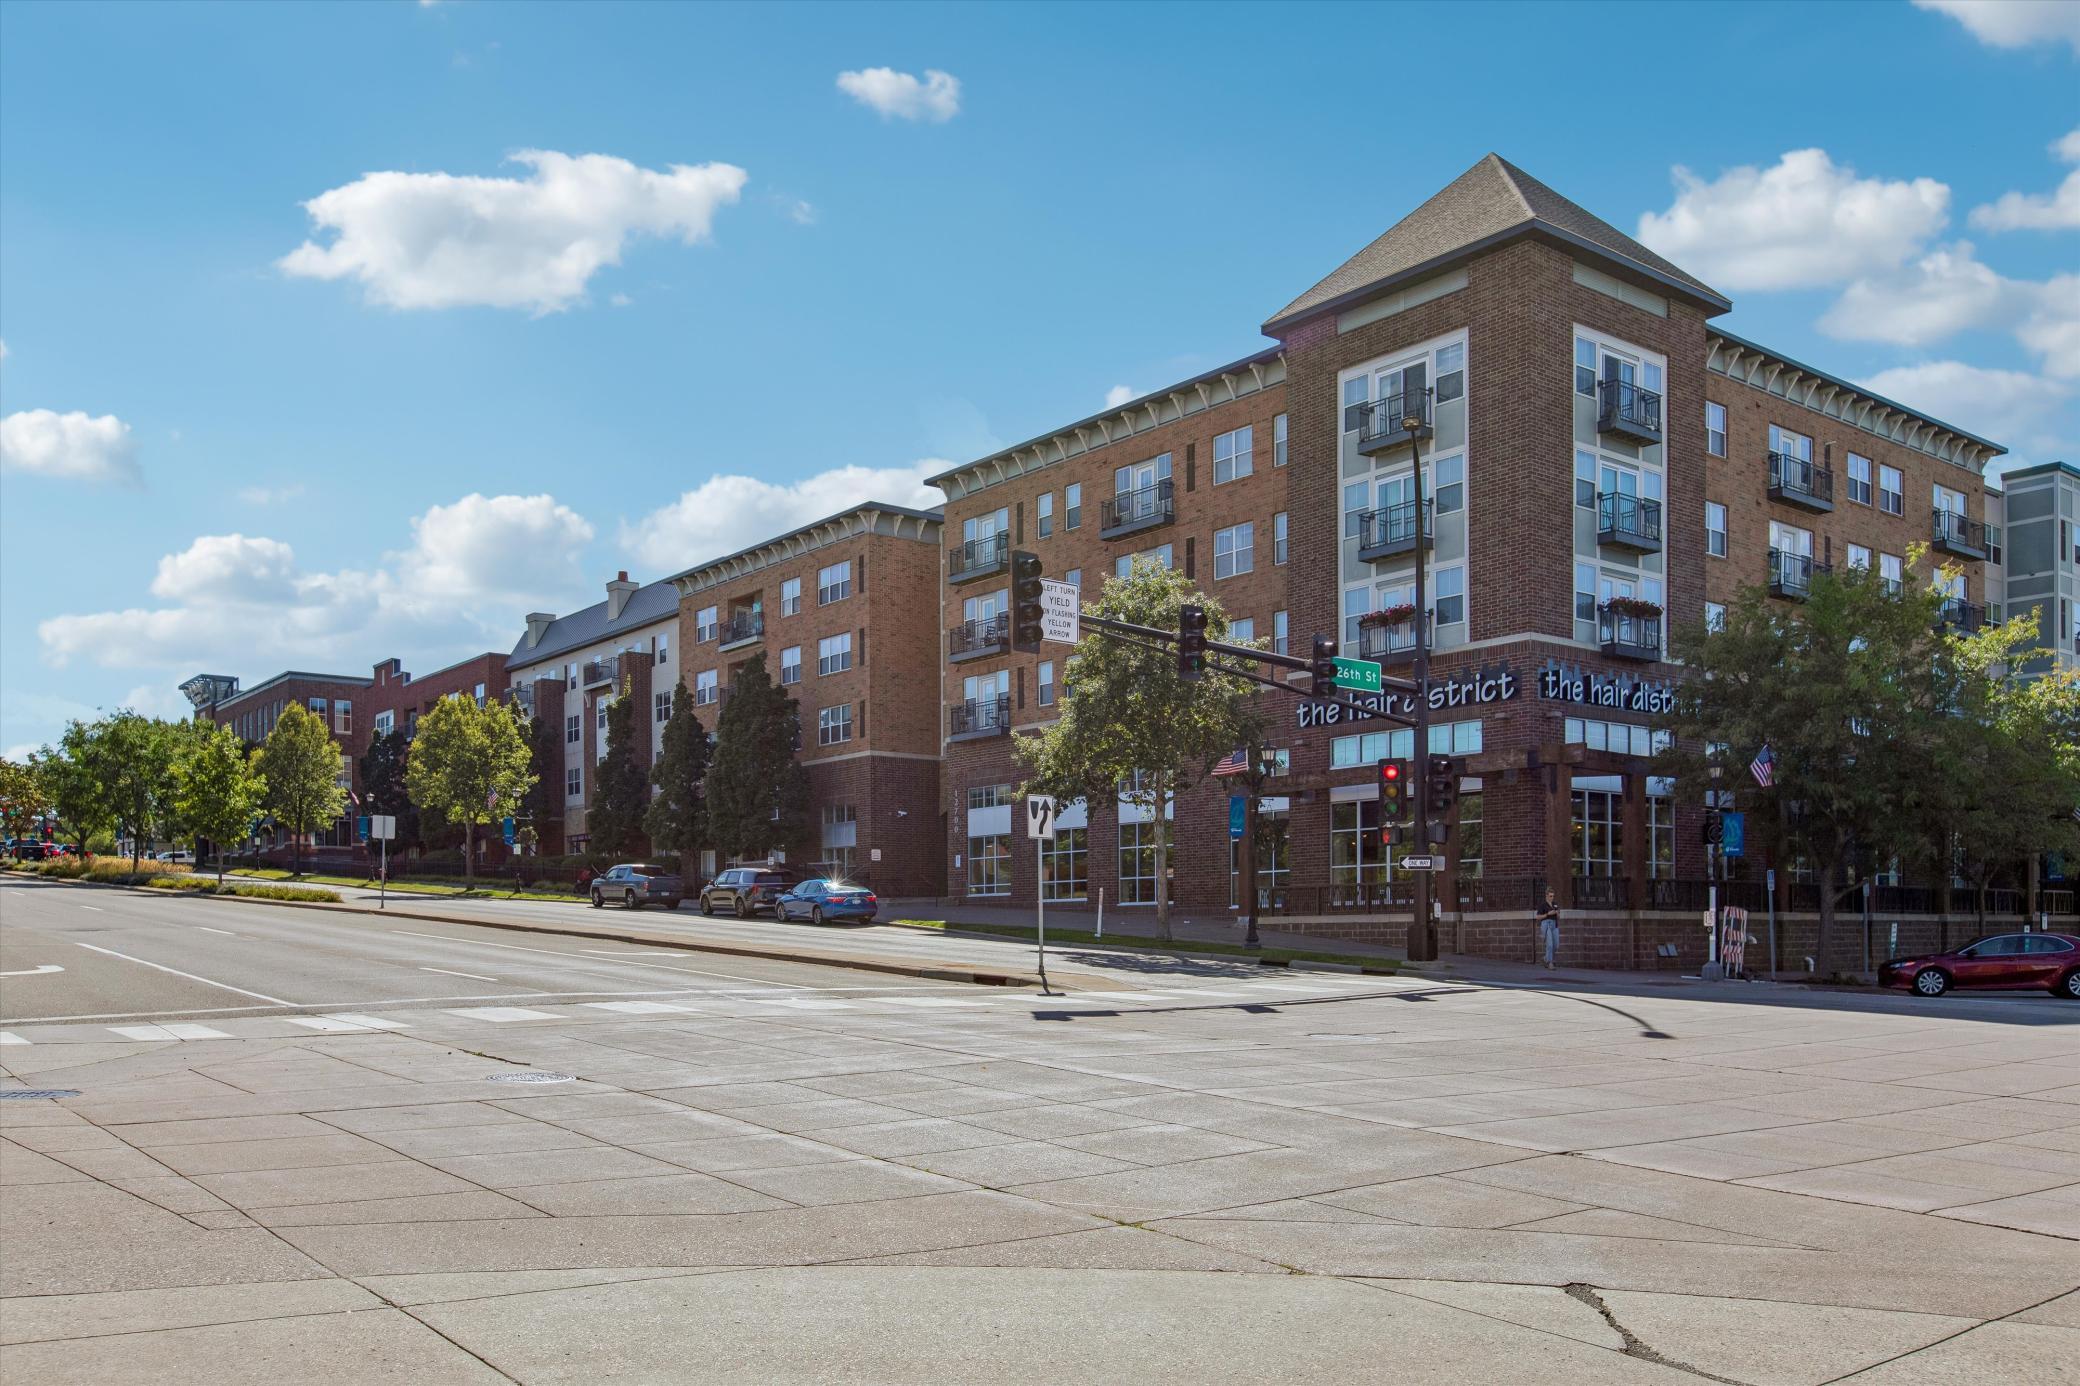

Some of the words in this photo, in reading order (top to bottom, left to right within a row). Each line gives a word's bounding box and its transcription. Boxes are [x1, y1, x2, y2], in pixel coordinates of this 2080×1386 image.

[1043, 585, 1057, 593] LEFT
[1060, 587, 1075, 596] TURN
[1049, 596, 1070, 607] YIELD
[1052, 609, 1076, 619] FLASHING
[1048, 619, 1071, 628] YELLOW
[1049, 630, 1070, 638] ARROW
[1337, 667, 1360, 680] 26th
[1365, 671, 1377, 683] St
[1545, 669, 1583, 701] the
[1591, 674, 1630, 708] hair
[1296, 702, 1340, 728] the
